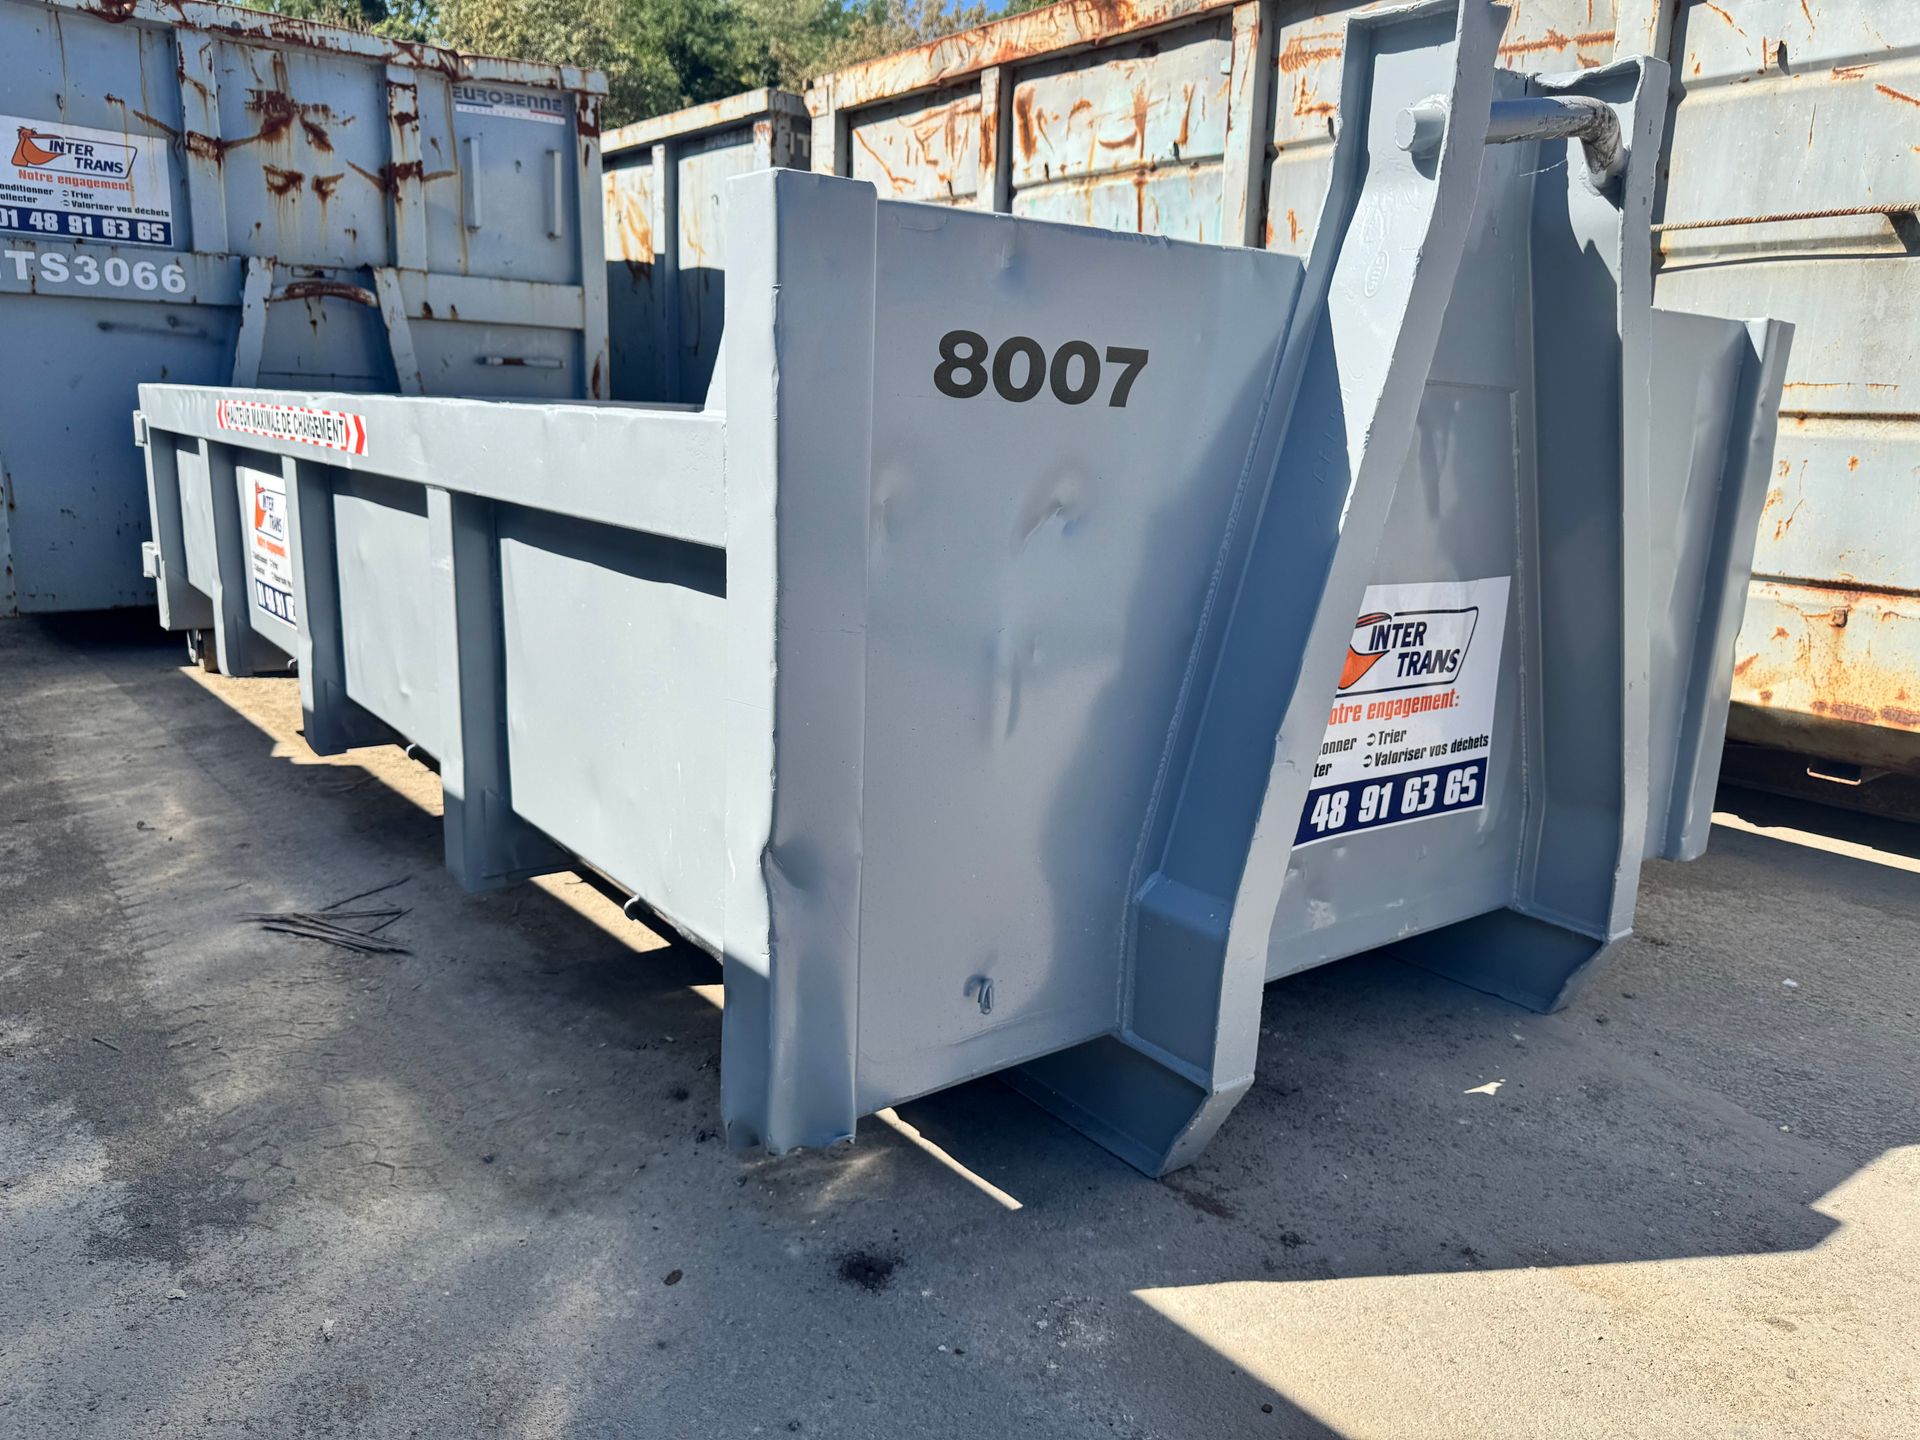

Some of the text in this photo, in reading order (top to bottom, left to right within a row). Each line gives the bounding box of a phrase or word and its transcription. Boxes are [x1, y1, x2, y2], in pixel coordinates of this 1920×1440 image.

[49, 139, 94, 157] INTER
[18, 169, 53, 183] Notre
[74, 157, 124, 173] TRANS
[0, 183, 54, 196] onditionner
[0, 193, 38, 204] ollecter
[70, 190, 94, 199] Trier
[71, 200, 170, 217] Valoriser vos déchets
[29, 211, 59, 232] 48
[68, 215, 93, 235] 91
[102, 218, 130, 239] 63
[137, 222, 165, 242] 65
[0, 250, 186, 294] TS3066
[933, 330, 1149, 408] 8007
[281, 412, 292, 434] DE
[293, 413, 344, 443] CHARGEMENT
[1368, 621, 1427, 651] INTER
[1397, 648, 1460, 678] TRANS
[1328, 688, 1460, 726] otre engagement:
[1374, 746, 1427, 767] Valoriser
[1429, 744, 1447, 757] vos
[1450, 733, 1489, 753] déchets
[1378, 729, 1407, 746] Trier
[1310, 766, 1479, 833] 48 91 63 65
